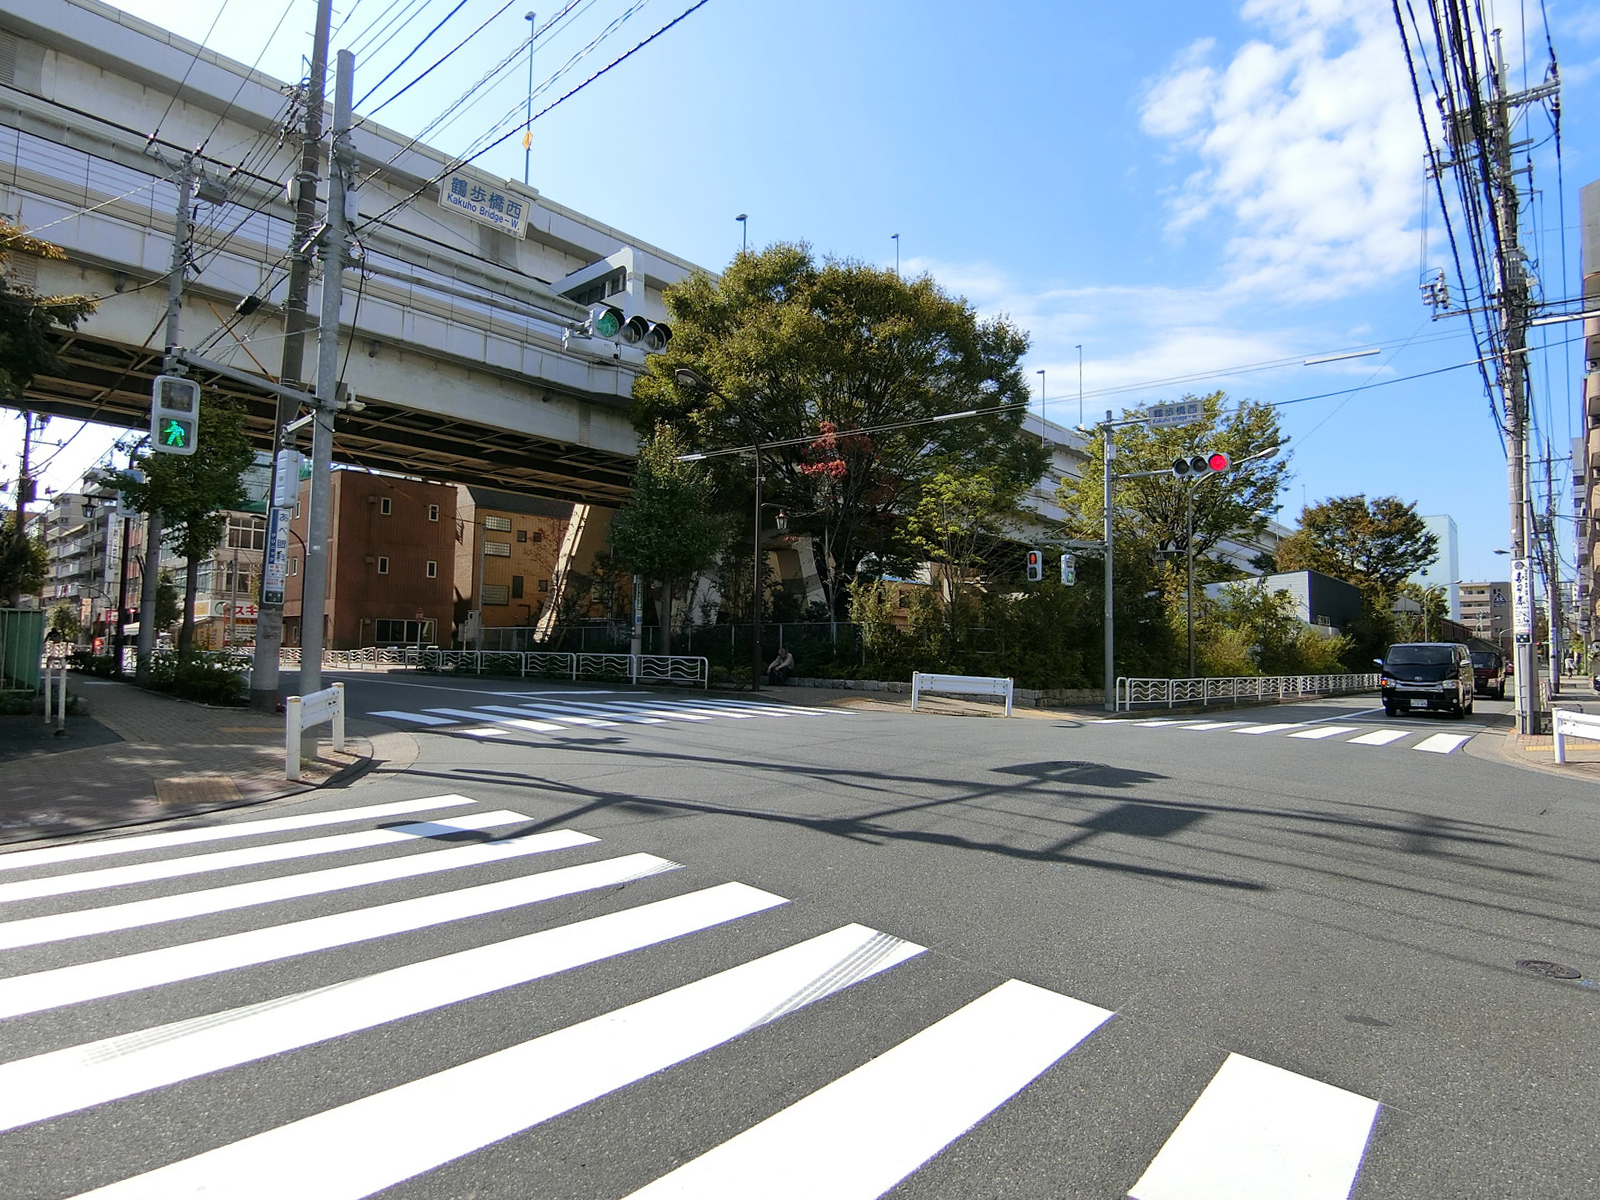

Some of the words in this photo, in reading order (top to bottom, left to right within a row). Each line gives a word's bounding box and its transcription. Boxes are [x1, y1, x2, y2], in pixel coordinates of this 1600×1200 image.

[447, 193, 477, 212] Kakuho
[451, 177, 523, 219] 鶴歩橋西
[276, 513, 289, 562] あべ眼科
